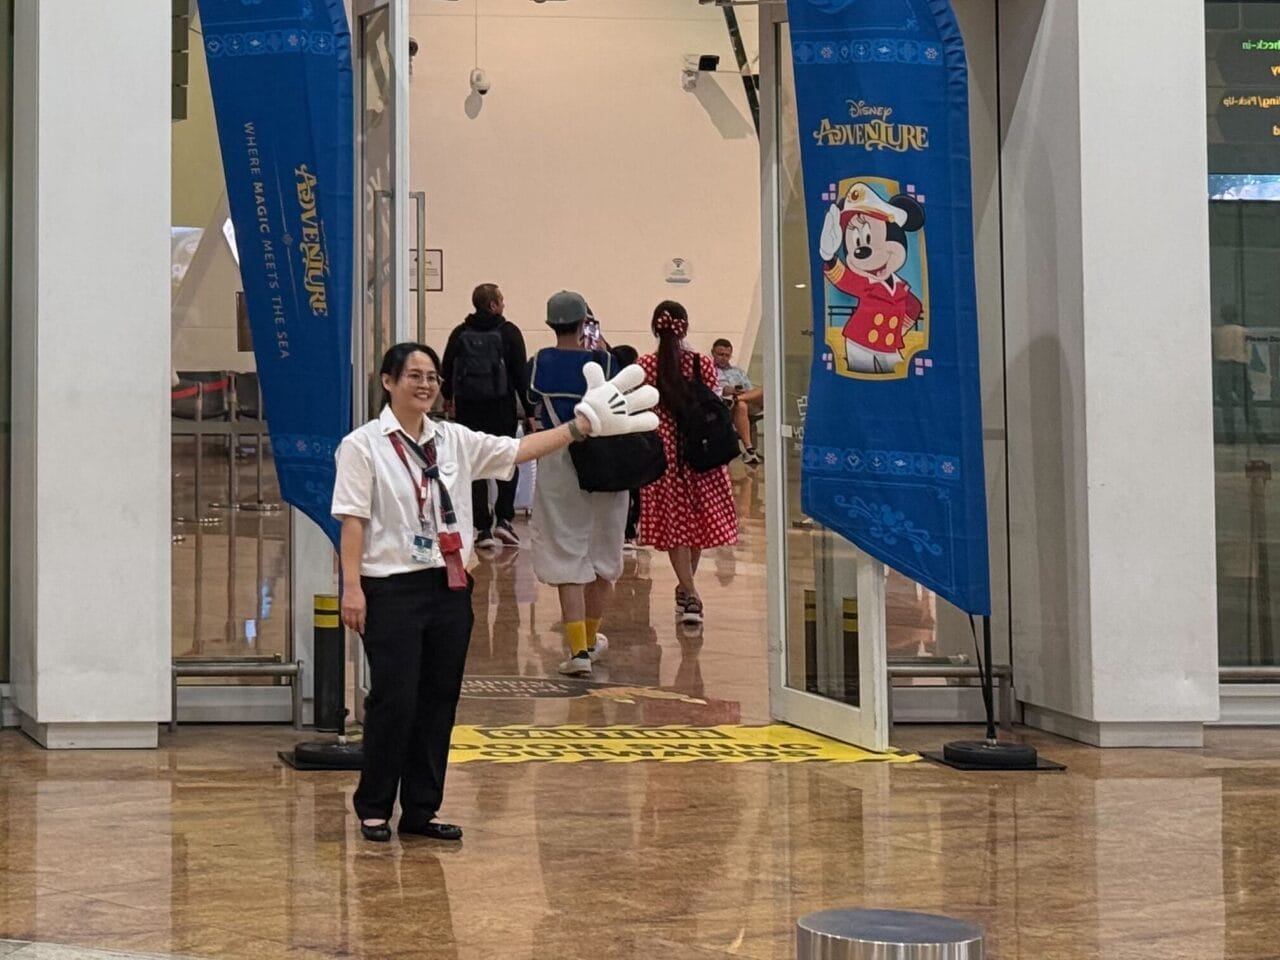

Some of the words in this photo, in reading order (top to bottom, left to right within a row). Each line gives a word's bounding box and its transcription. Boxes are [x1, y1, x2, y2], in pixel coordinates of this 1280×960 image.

[846, 99, 893, 122] Disney
[244, 121, 262, 176] WHERE
[812, 118, 929, 153] ADVENTURE
[253, 181, 270, 234] MAGIC
[294, 162, 329, 318] ADVENTURE
[262, 239, 280, 290] MEETS
[271, 295, 286, 325] THE
[276, 331, 291, 360] SEA
[492, 729, 723, 739] CAUTION
[479, 750, 817, 758] OUTWARDS
